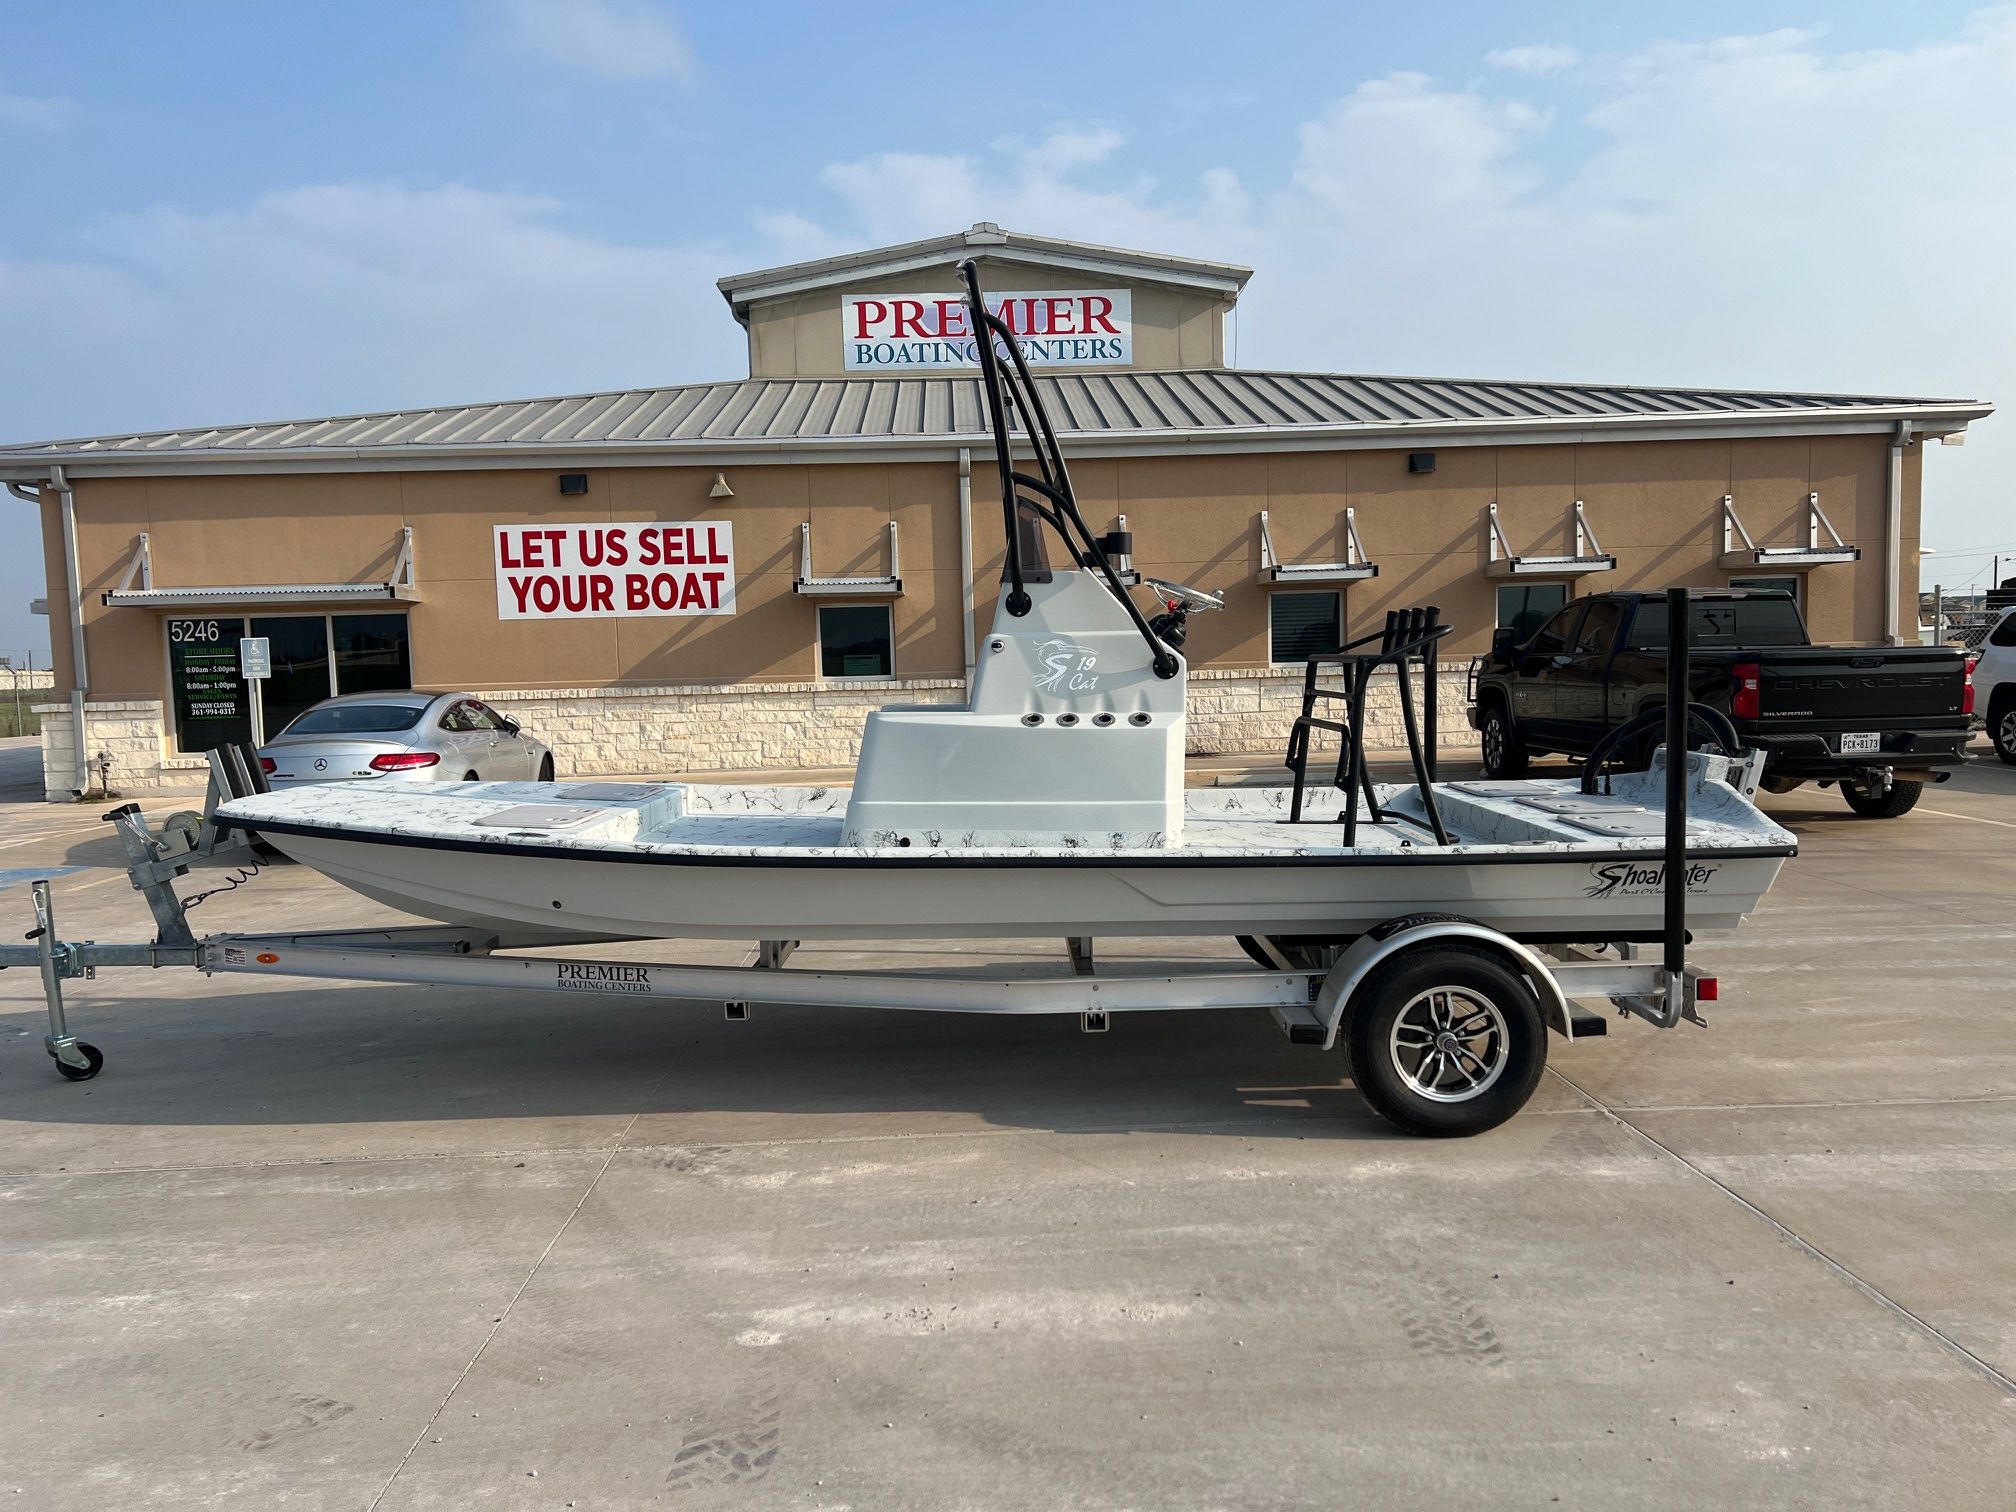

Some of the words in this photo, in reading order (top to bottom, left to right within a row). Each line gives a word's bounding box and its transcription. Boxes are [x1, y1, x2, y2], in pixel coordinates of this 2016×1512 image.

[500, 530, 567, 568] LET
[578, 528, 628, 567] US
[638, 527, 729, 566] SELL
[507, 574, 615, 613] YOUR
[625, 572, 725, 611] BOAT
[171, 620, 219, 642] 5246
[184, 648, 208, 656] STORE
[209, 647, 235, 655] HOURS
[1076, 656, 1097, 671] 19
[186, 682, 210, 690] 8:00am
[213, 682, 237, 690] 1:00pm
[1068, 673, 1099, 691] Cat
[1588, 862, 1717, 898] Shoalter
[556, 963, 651, 983] PREMIER
[557, 979, 603, 990] BOATING
[604, 981, 652, 993] CENTERS
